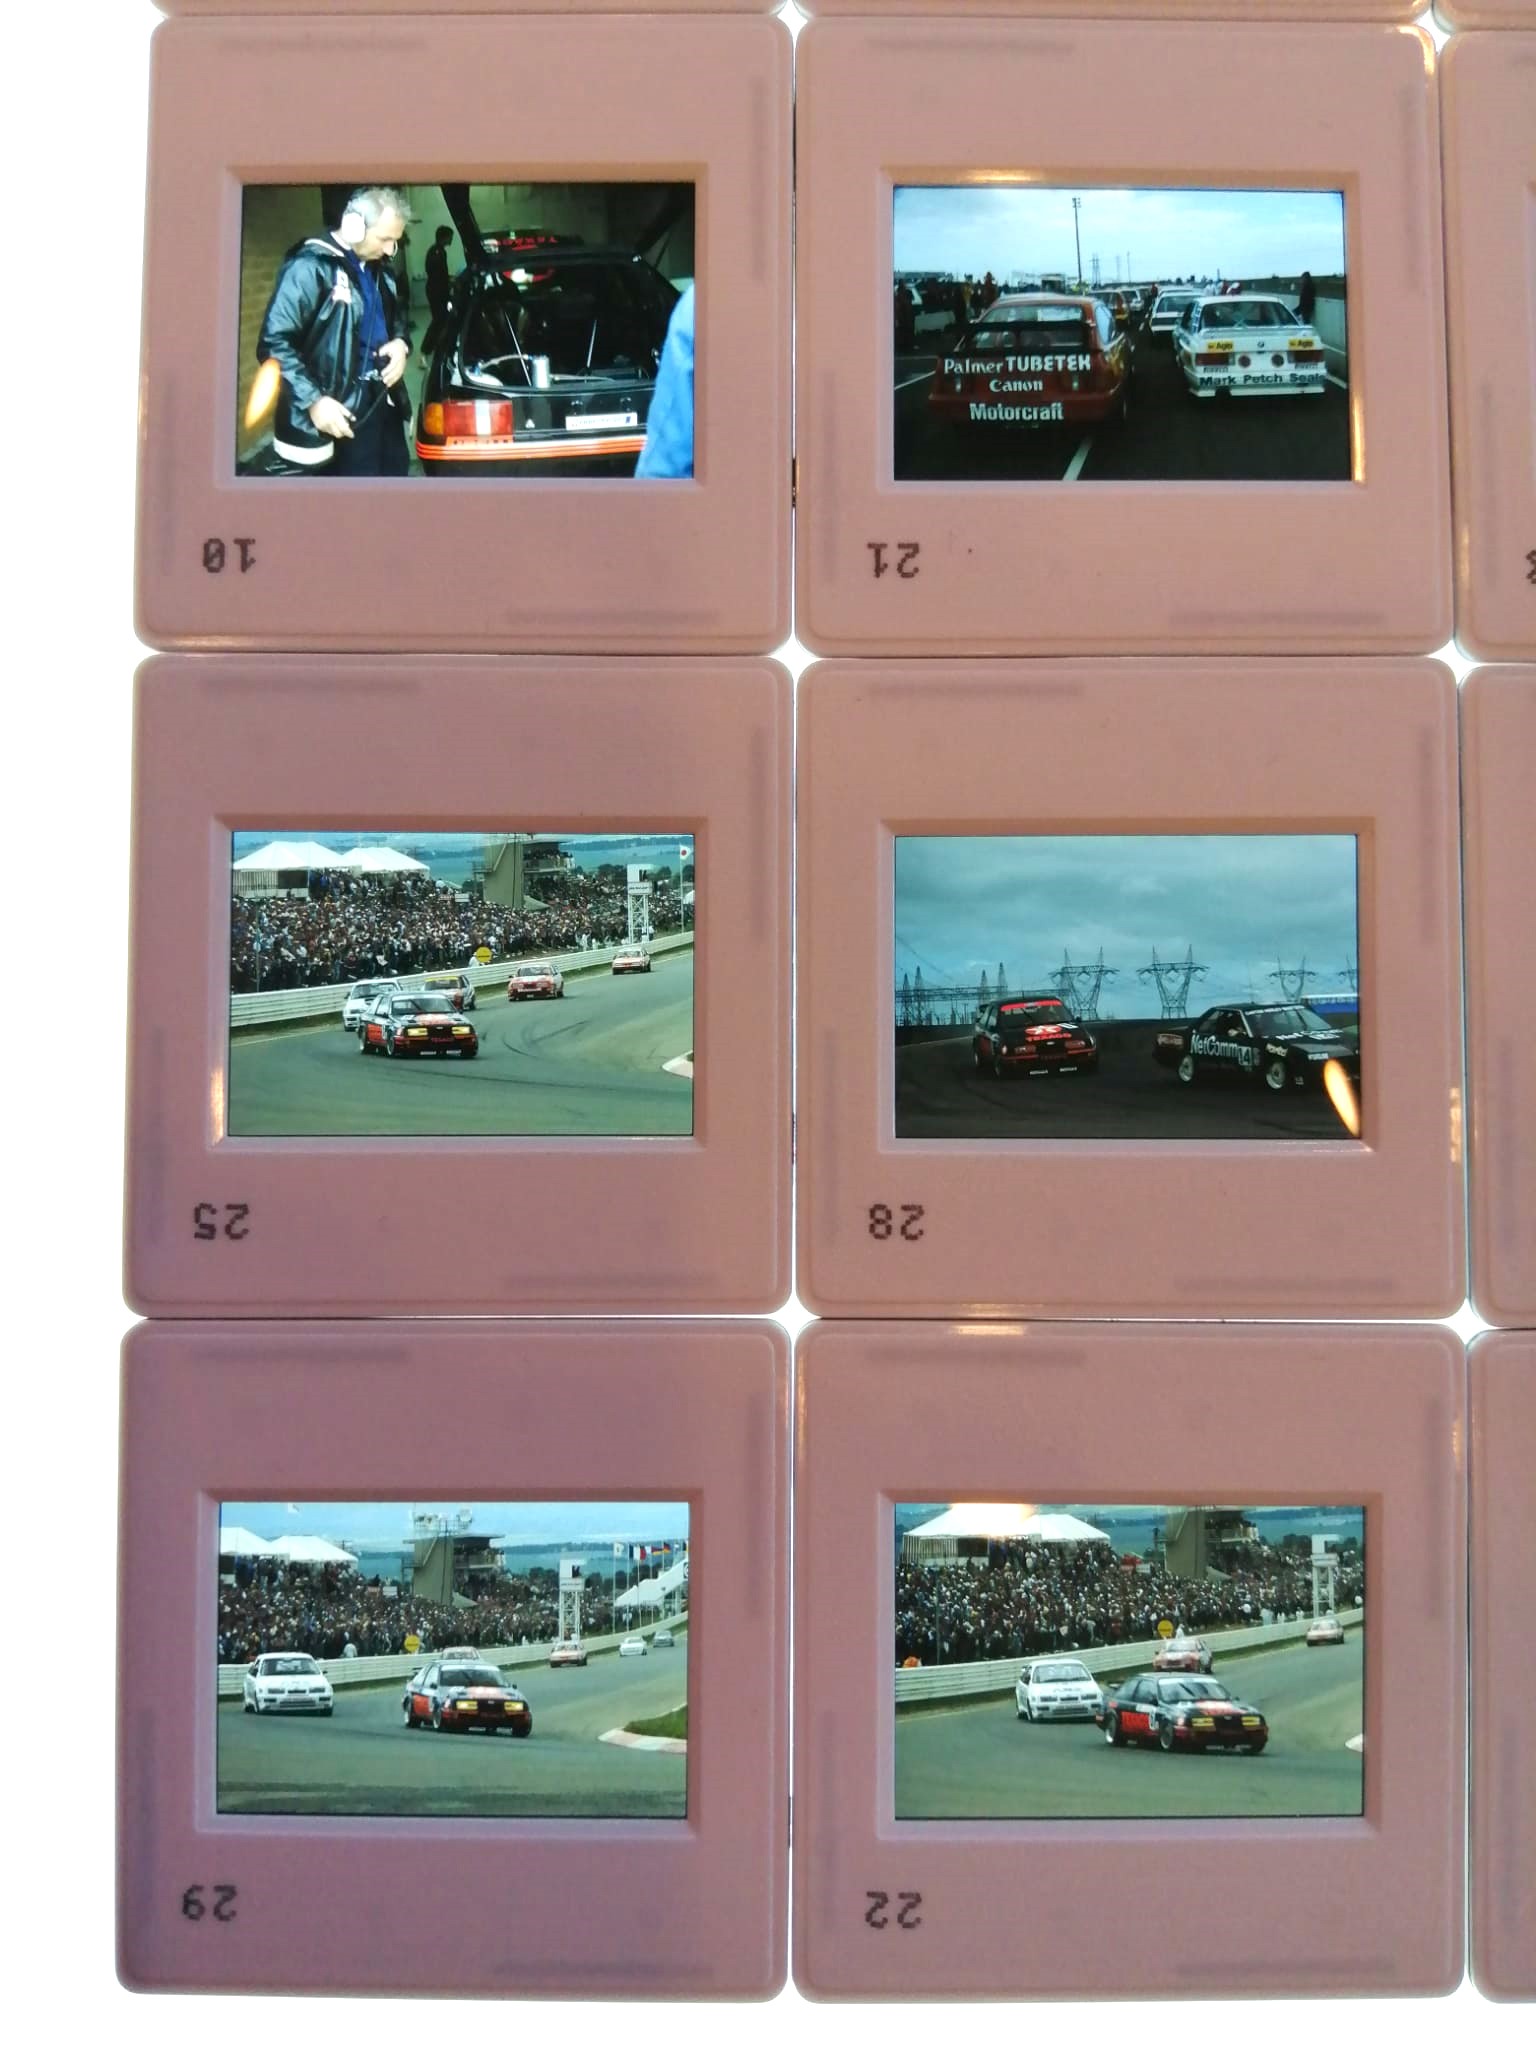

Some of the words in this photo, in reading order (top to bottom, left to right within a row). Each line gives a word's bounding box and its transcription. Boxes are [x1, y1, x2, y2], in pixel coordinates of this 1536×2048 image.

[944, 357, 1004, 374] Palmer
[1200, 376, 1237, 387] Mark
[1243, 373, 1283, 385] Petch
[989, 379, 1044, 392] Canon
[969, 402, 1065, 421] Motorcraft
[203, 538, 256, 573] 10
[867, 542, 919, 578] 21
[1190, 1034, 1238, 1057] NetComm
[194, 1203, 249, 1240] 25
[869, 1204, 924, 1240] 28
[183, 1885, 237, 1921] 29
[865, 1891, 921, 1929] 22
